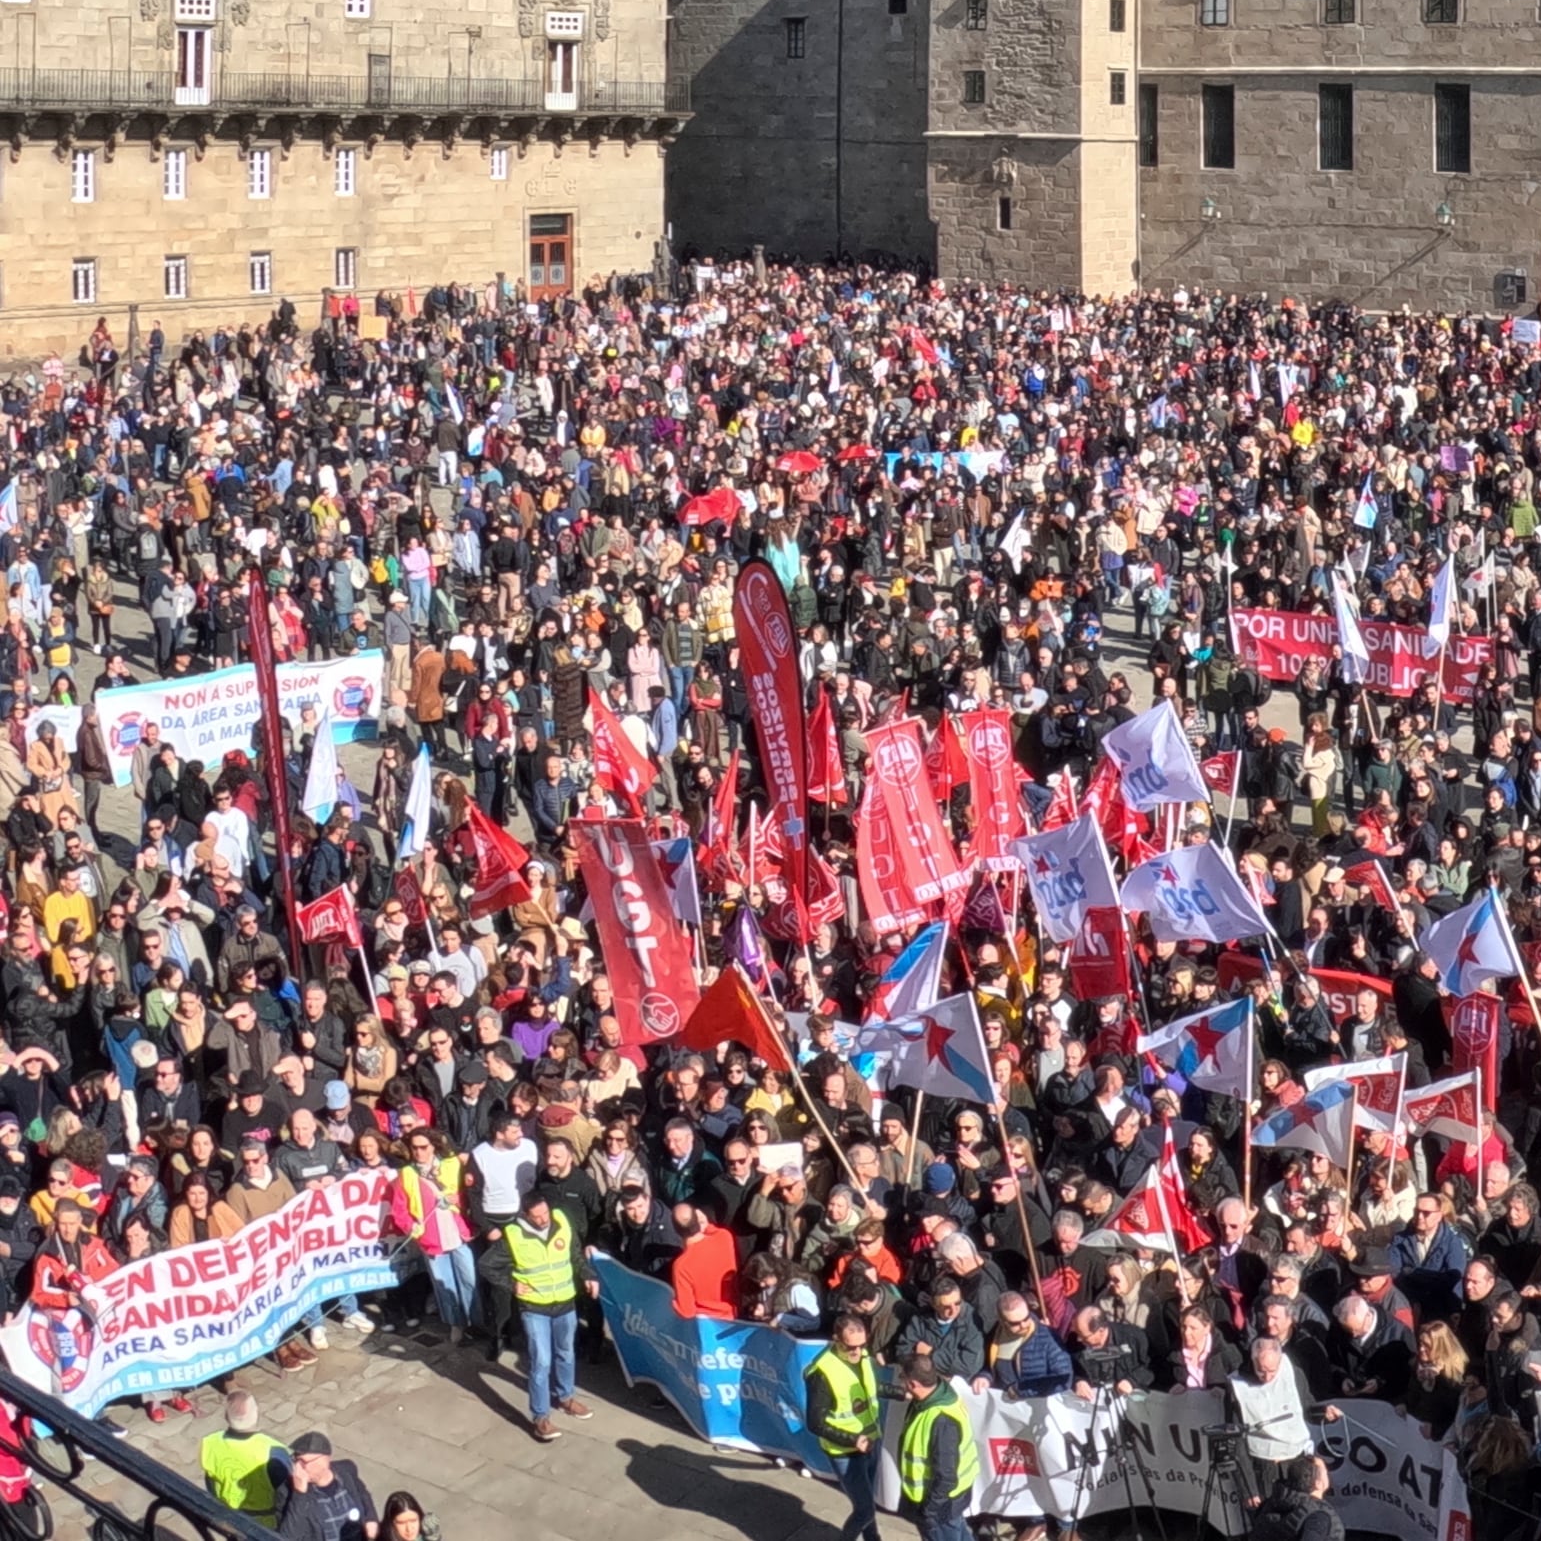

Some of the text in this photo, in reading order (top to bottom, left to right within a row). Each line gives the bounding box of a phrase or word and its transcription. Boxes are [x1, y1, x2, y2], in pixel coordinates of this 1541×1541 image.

[1234, 613, 1491, 665] POR UNH SANIADE
[1277, 654, 1334, 677] 10%
[161, 715, 185, 730] DA
[233, 691, 323, 716] SANTARIA
[164, 686, 206, 710] NON
[198, 730, 215, 746] DA
[593, 826, 658, 987] UGT
[103, 1175, 394, 1308] EN DEFENSA DA
[102, 1264, 267, 1344] SANIDADE
[174, 1284, 283, 1345] SANITARIA
[291, 1266, 306, 1290] DA
[1317, 1436, 1387, 1473] SO
[1074, 1464, 1161, 1492] Socialisas
[1166, 1467, 1186, 1483] da
[1340, 1481, 1401, 1509] defensa
